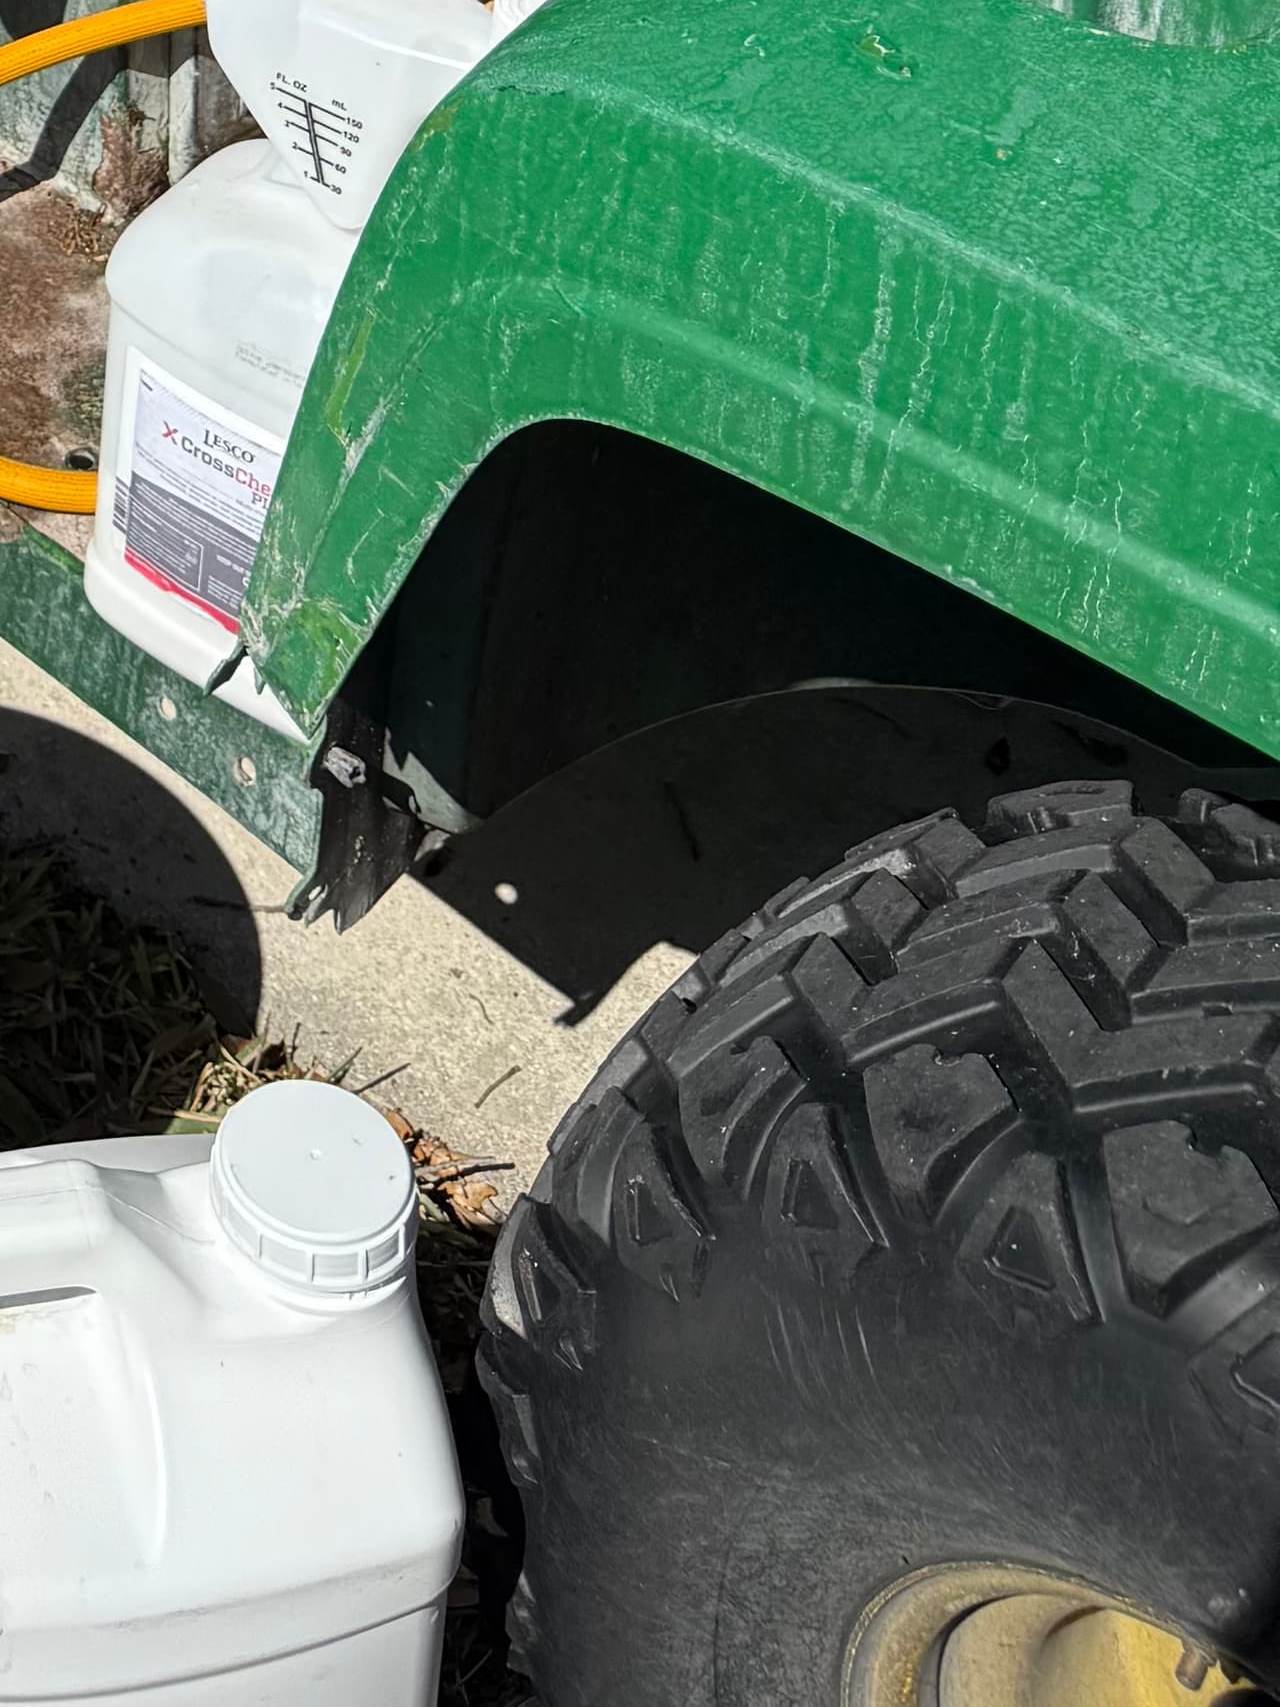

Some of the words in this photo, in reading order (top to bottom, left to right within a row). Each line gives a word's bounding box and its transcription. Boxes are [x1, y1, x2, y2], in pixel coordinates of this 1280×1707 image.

[292, 80, 307, 92] OZ
[346, 117, 363, 129] 150
[343, 131, 360, 143] 120
[203, 429, 255, 464] LESCO
[181, 435, 271, 497] CrossChe
